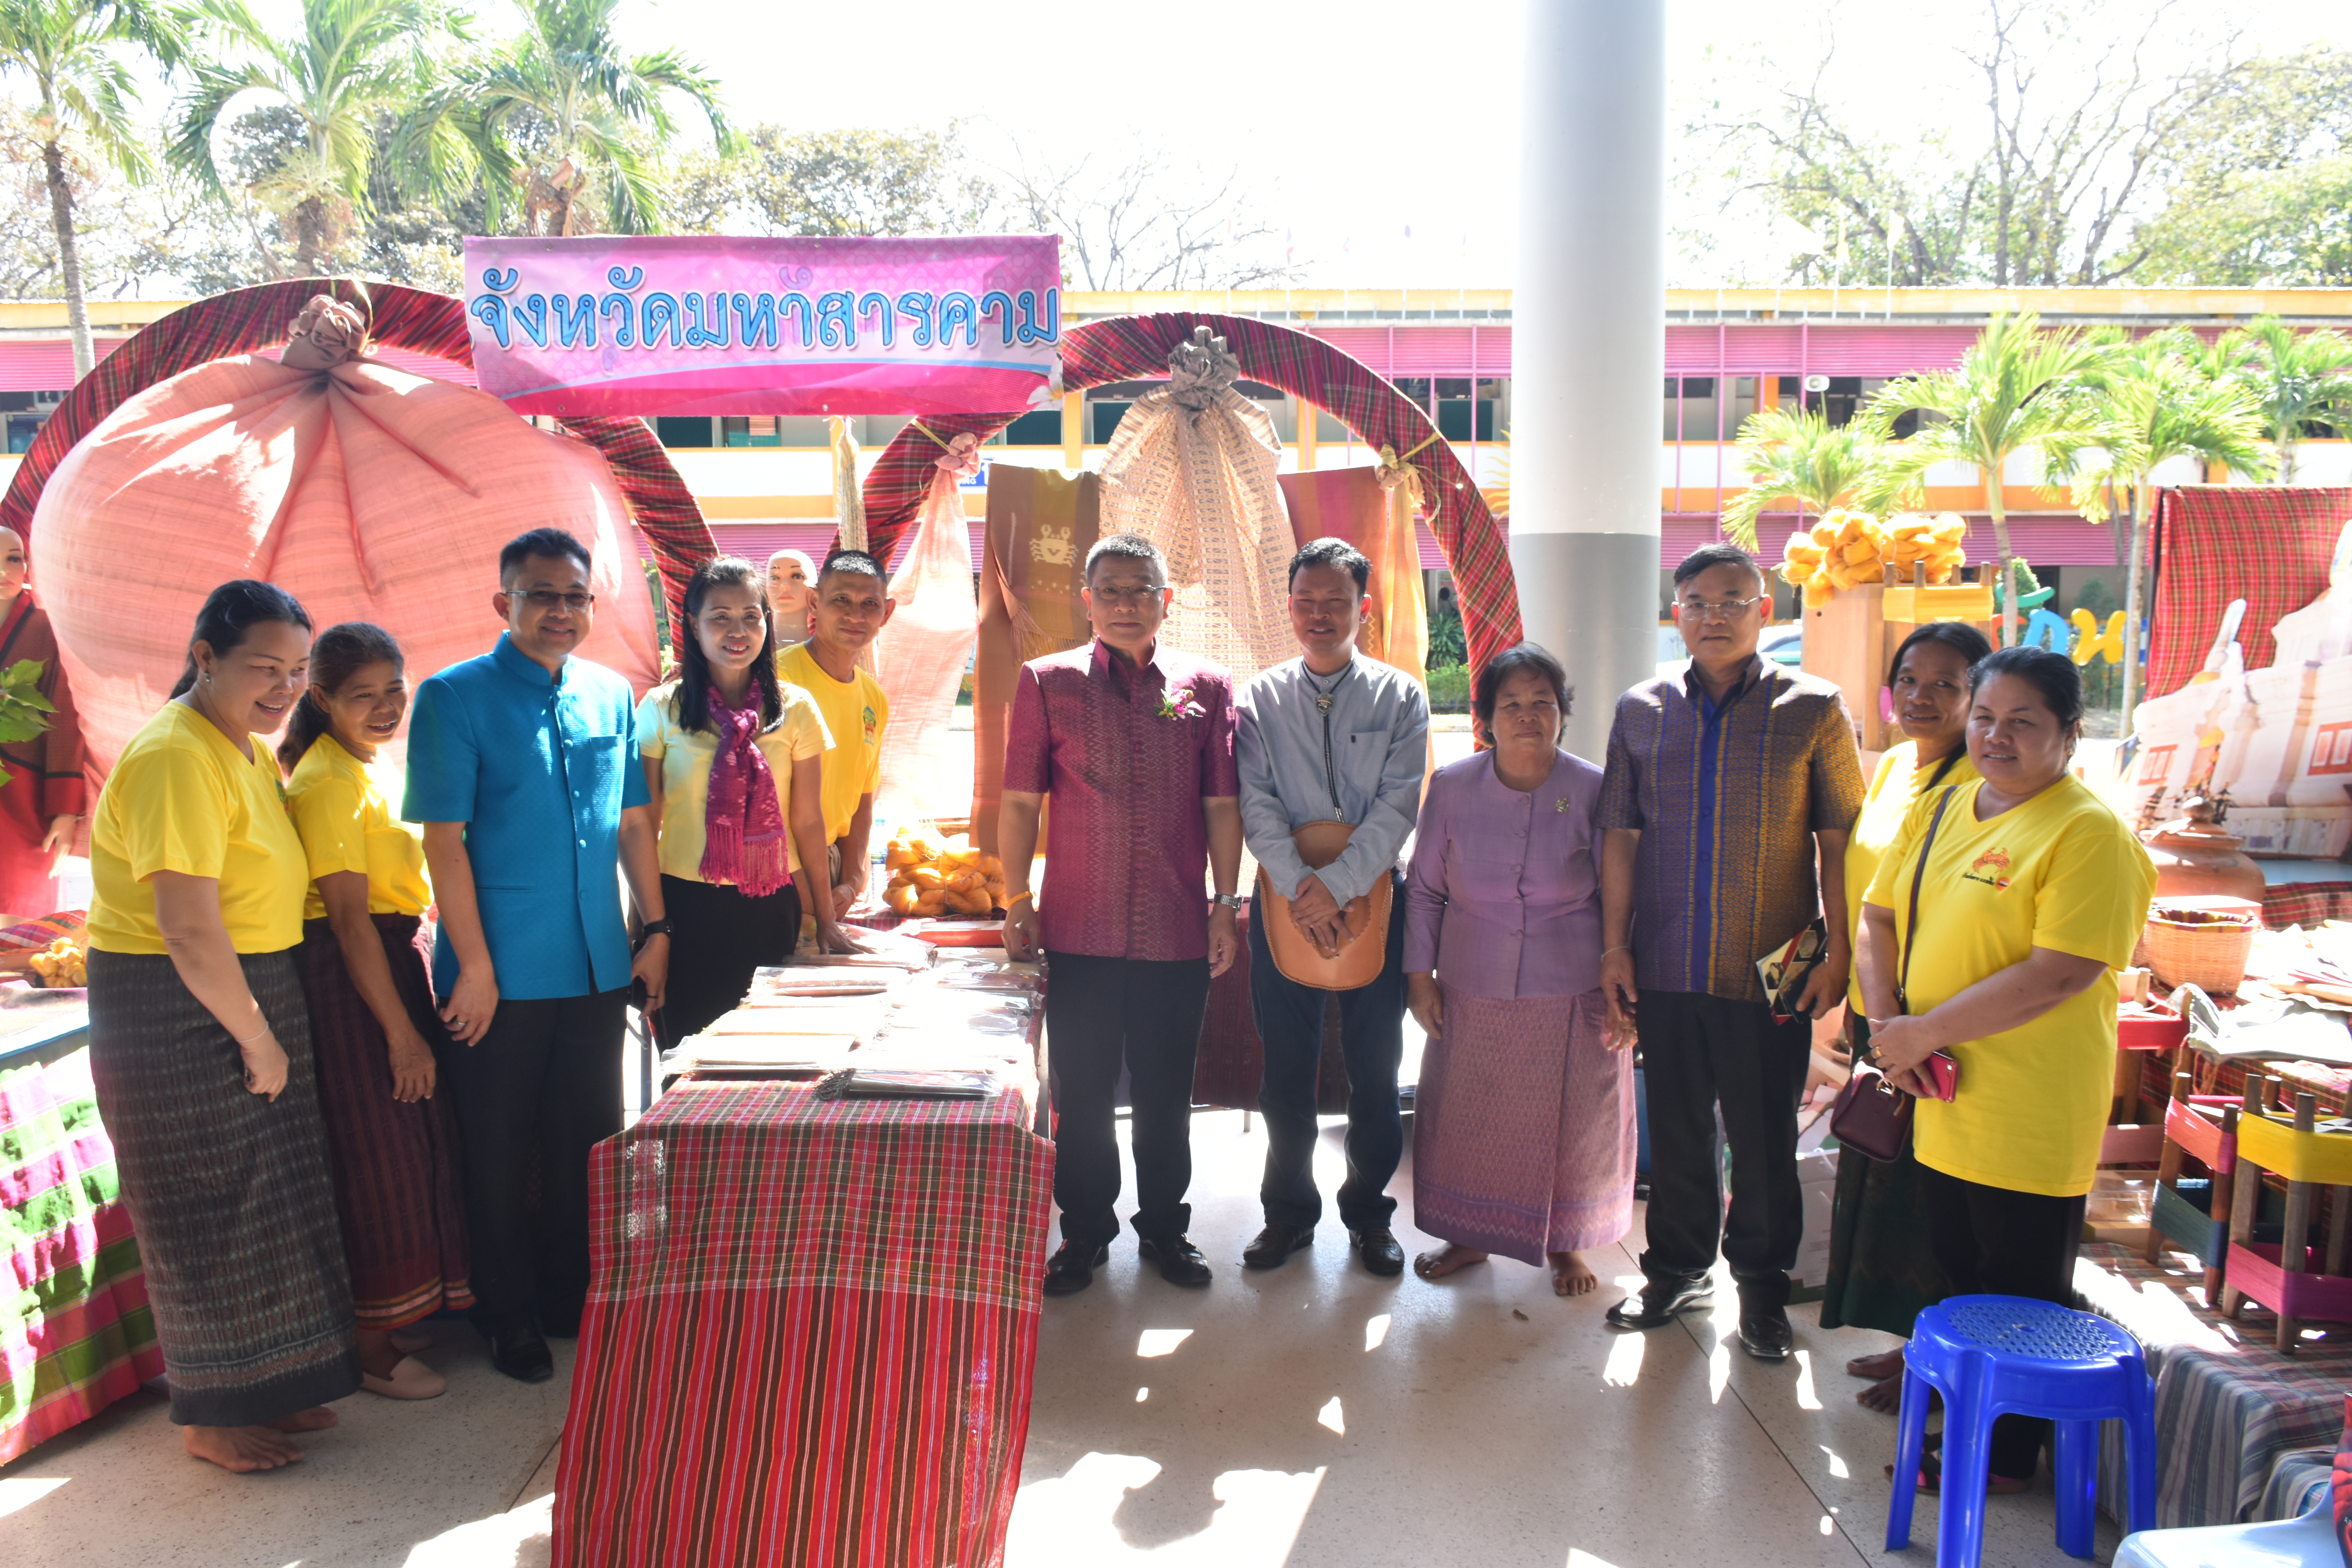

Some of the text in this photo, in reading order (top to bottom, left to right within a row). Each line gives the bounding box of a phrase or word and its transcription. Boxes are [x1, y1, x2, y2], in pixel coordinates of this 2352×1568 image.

[470, 265, 1060, 349] จังหวัดมหาสารคาม
